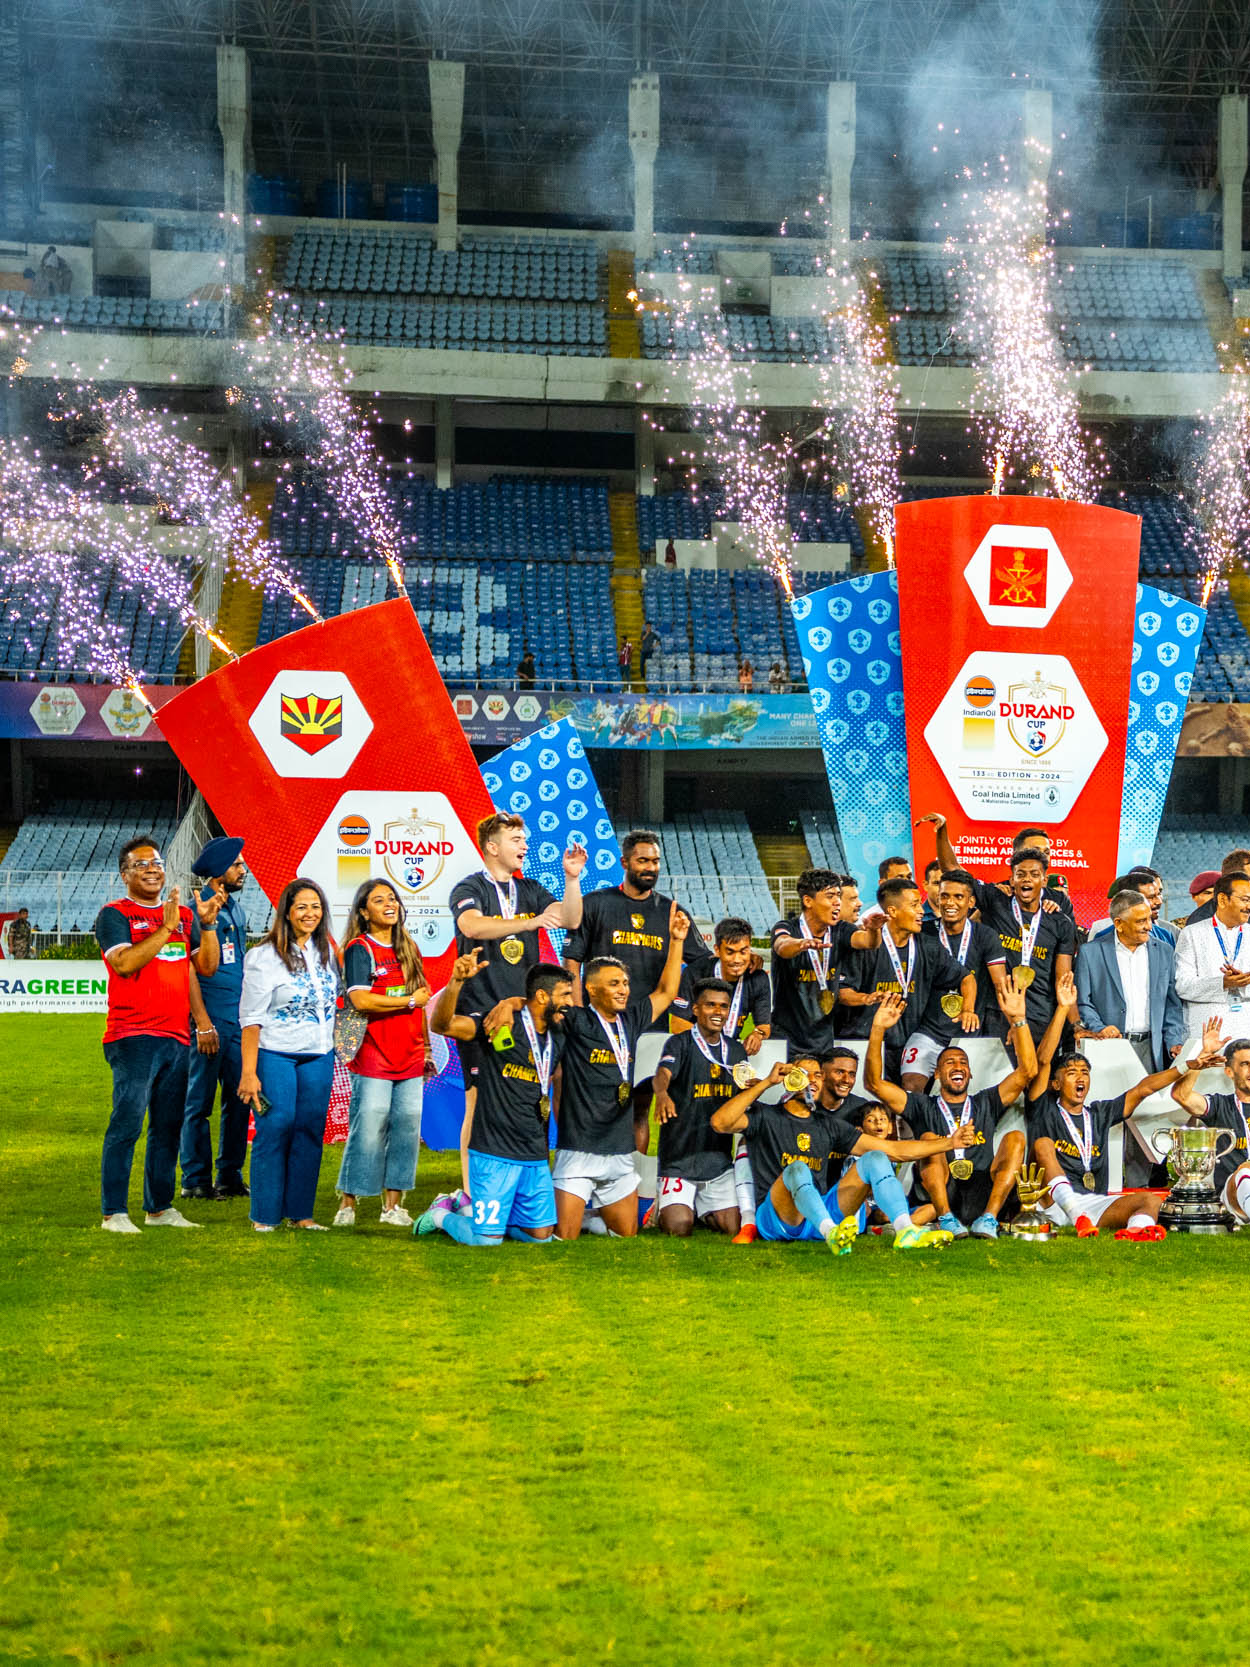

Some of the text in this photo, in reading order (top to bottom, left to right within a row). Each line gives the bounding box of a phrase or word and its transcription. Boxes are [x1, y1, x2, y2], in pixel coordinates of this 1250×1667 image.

[963, 709, 996, 717] IndianOil
[1000, 702, 1075, 720] DURAND
[1027, 720, 1046, 728] CUP
[997, 771, 1031, 779] EDITION
[972, 790, 990, 798] Coal
[1012, 792, 1040, 800] Limited
[956, 836, 996, 845] JOINTLY
[1056, 838, 1069, 847] BY
[375, 841, 454, 855] DURAND
[963, 846, 999, 856] INDIAN
[404, 857, 424, 865] CUP
[1050, 860, 1089, 869] BENGAL
[474, 1200, 500, 1225] 32
